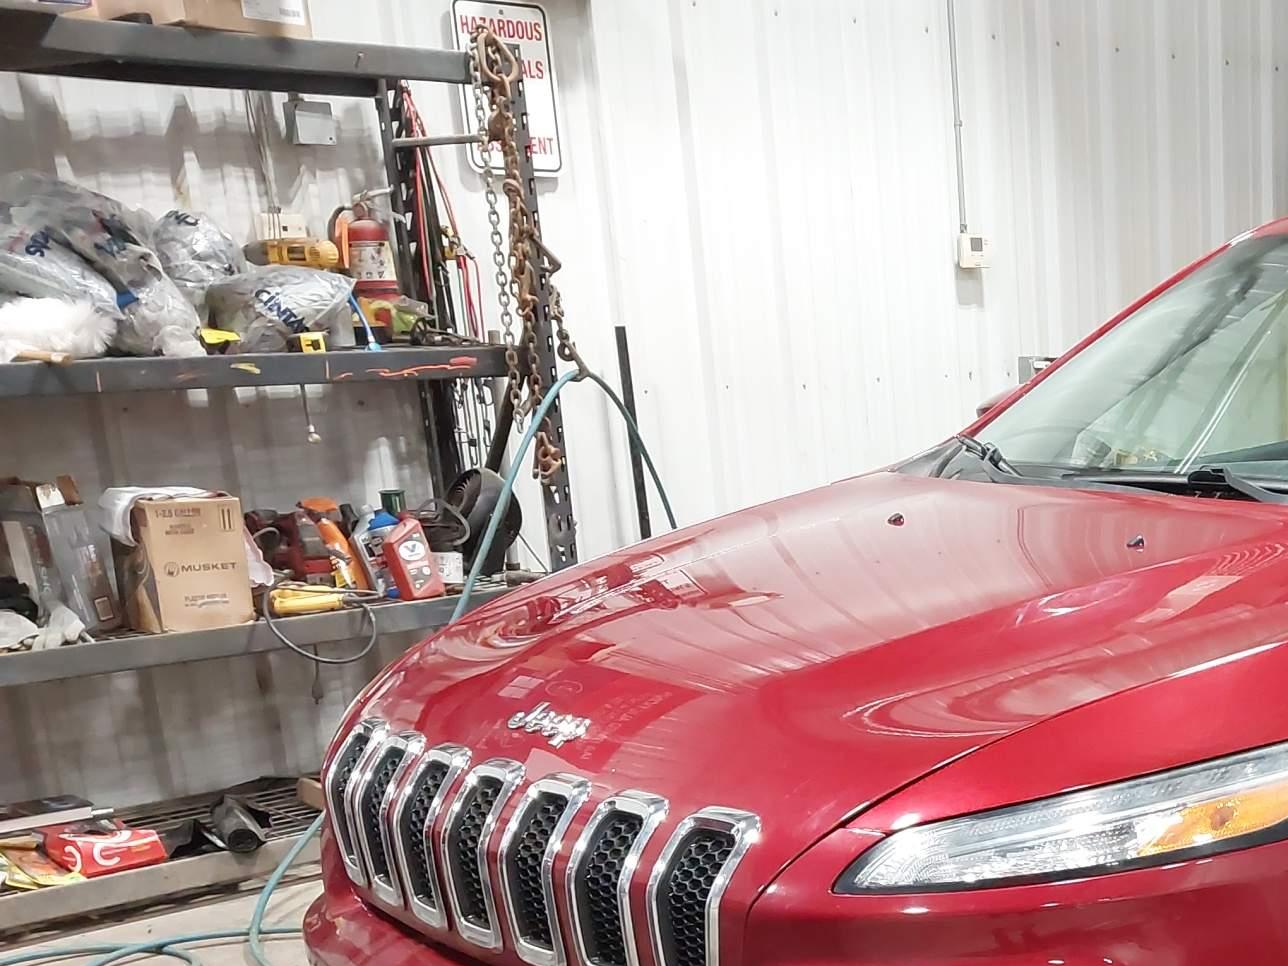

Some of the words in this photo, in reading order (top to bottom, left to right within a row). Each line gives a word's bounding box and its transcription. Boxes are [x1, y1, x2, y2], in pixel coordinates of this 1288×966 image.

[460, 15, 542, 41] HAZARDOUS
[181, 561, 237, 573] MUSKET
[507, 701, 592, 749] Jeep
